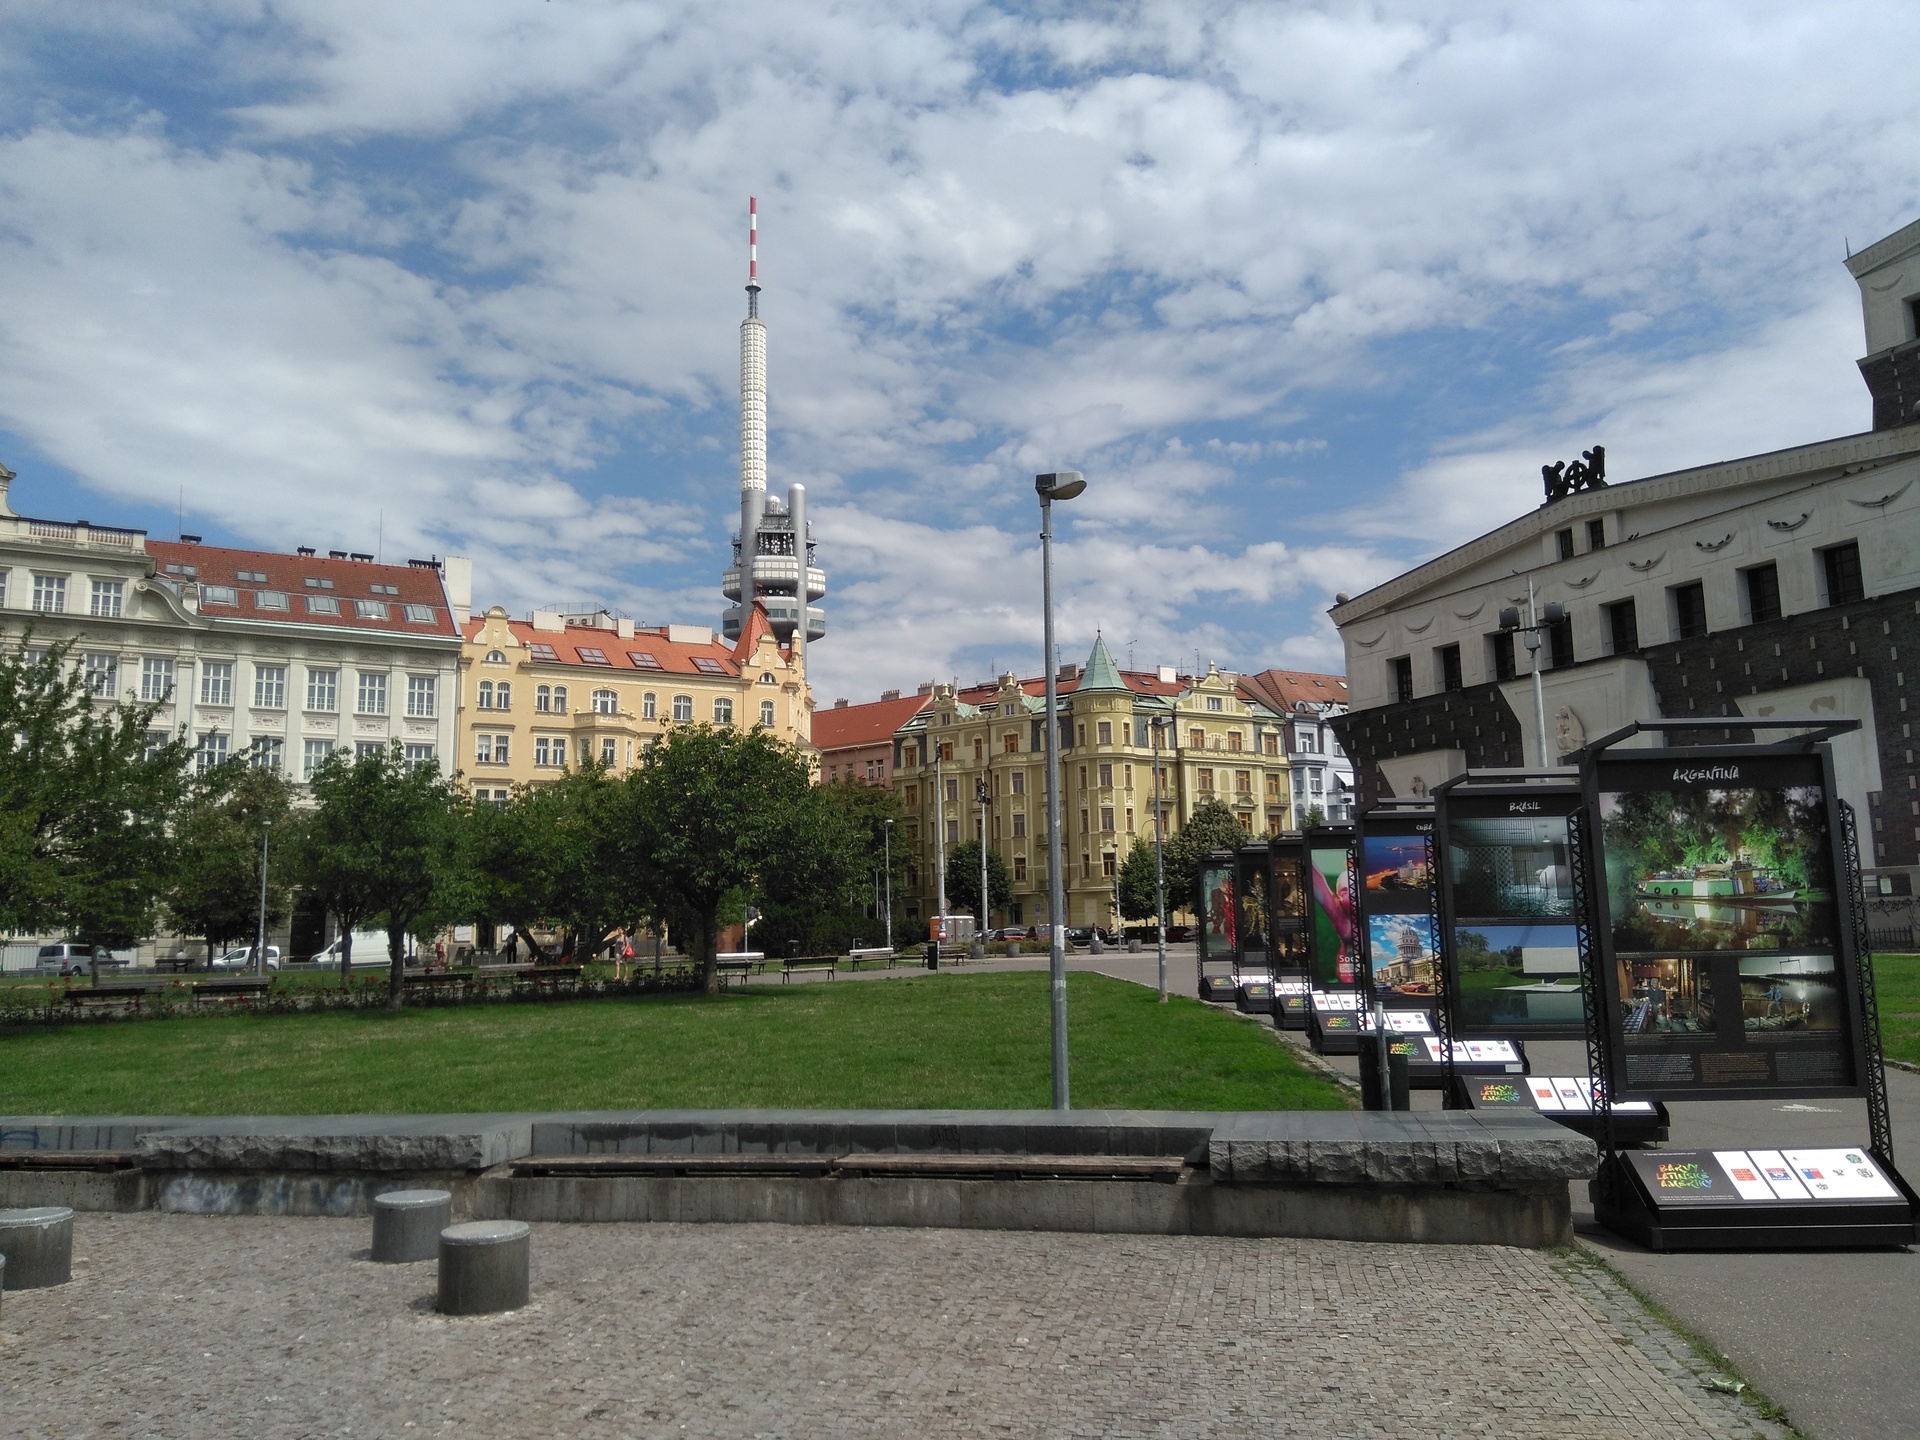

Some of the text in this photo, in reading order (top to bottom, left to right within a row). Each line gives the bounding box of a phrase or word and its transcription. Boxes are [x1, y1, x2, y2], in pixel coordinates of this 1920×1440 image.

[1672, 765, 1740, 783] ARGENTINA
[1509, 801, 1542, 812] BRASIL
[1658, 1163, 1698, 1173] BARVY
[1661, 1179, 1712, 1188] AMERIKY
